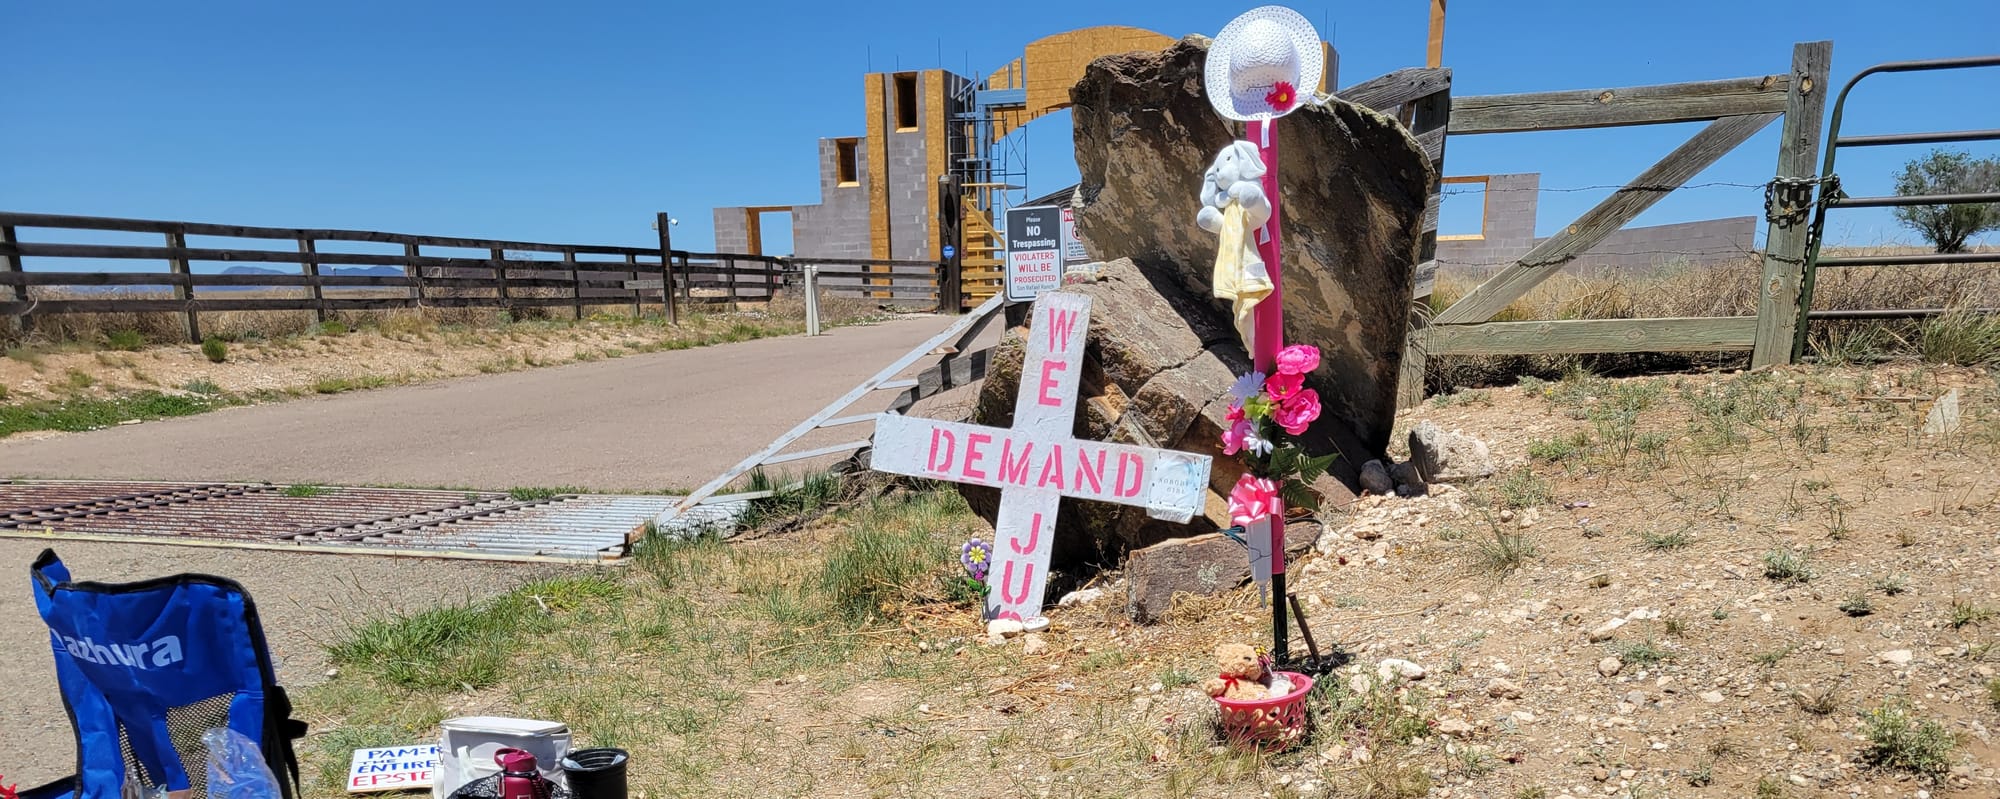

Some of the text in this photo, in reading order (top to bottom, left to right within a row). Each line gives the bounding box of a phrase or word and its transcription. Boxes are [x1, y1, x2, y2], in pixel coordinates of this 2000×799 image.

[1026, 226, 1041, 236] NO
[1012, 238, 1056, 249] Trespassing
[1014, 252, 1054, 261] VIOLATERS
[1018, 263, 1052, 272] WILL BE
[1014, 274, 1056, 283] PROSECUTED
[927, 427, 1143, 498] DEMAND
[51, 628, 183, 670] azhura
[357, 760, 438, 773] ENTIRE
[352, 771, 432, 786] EPSTE
